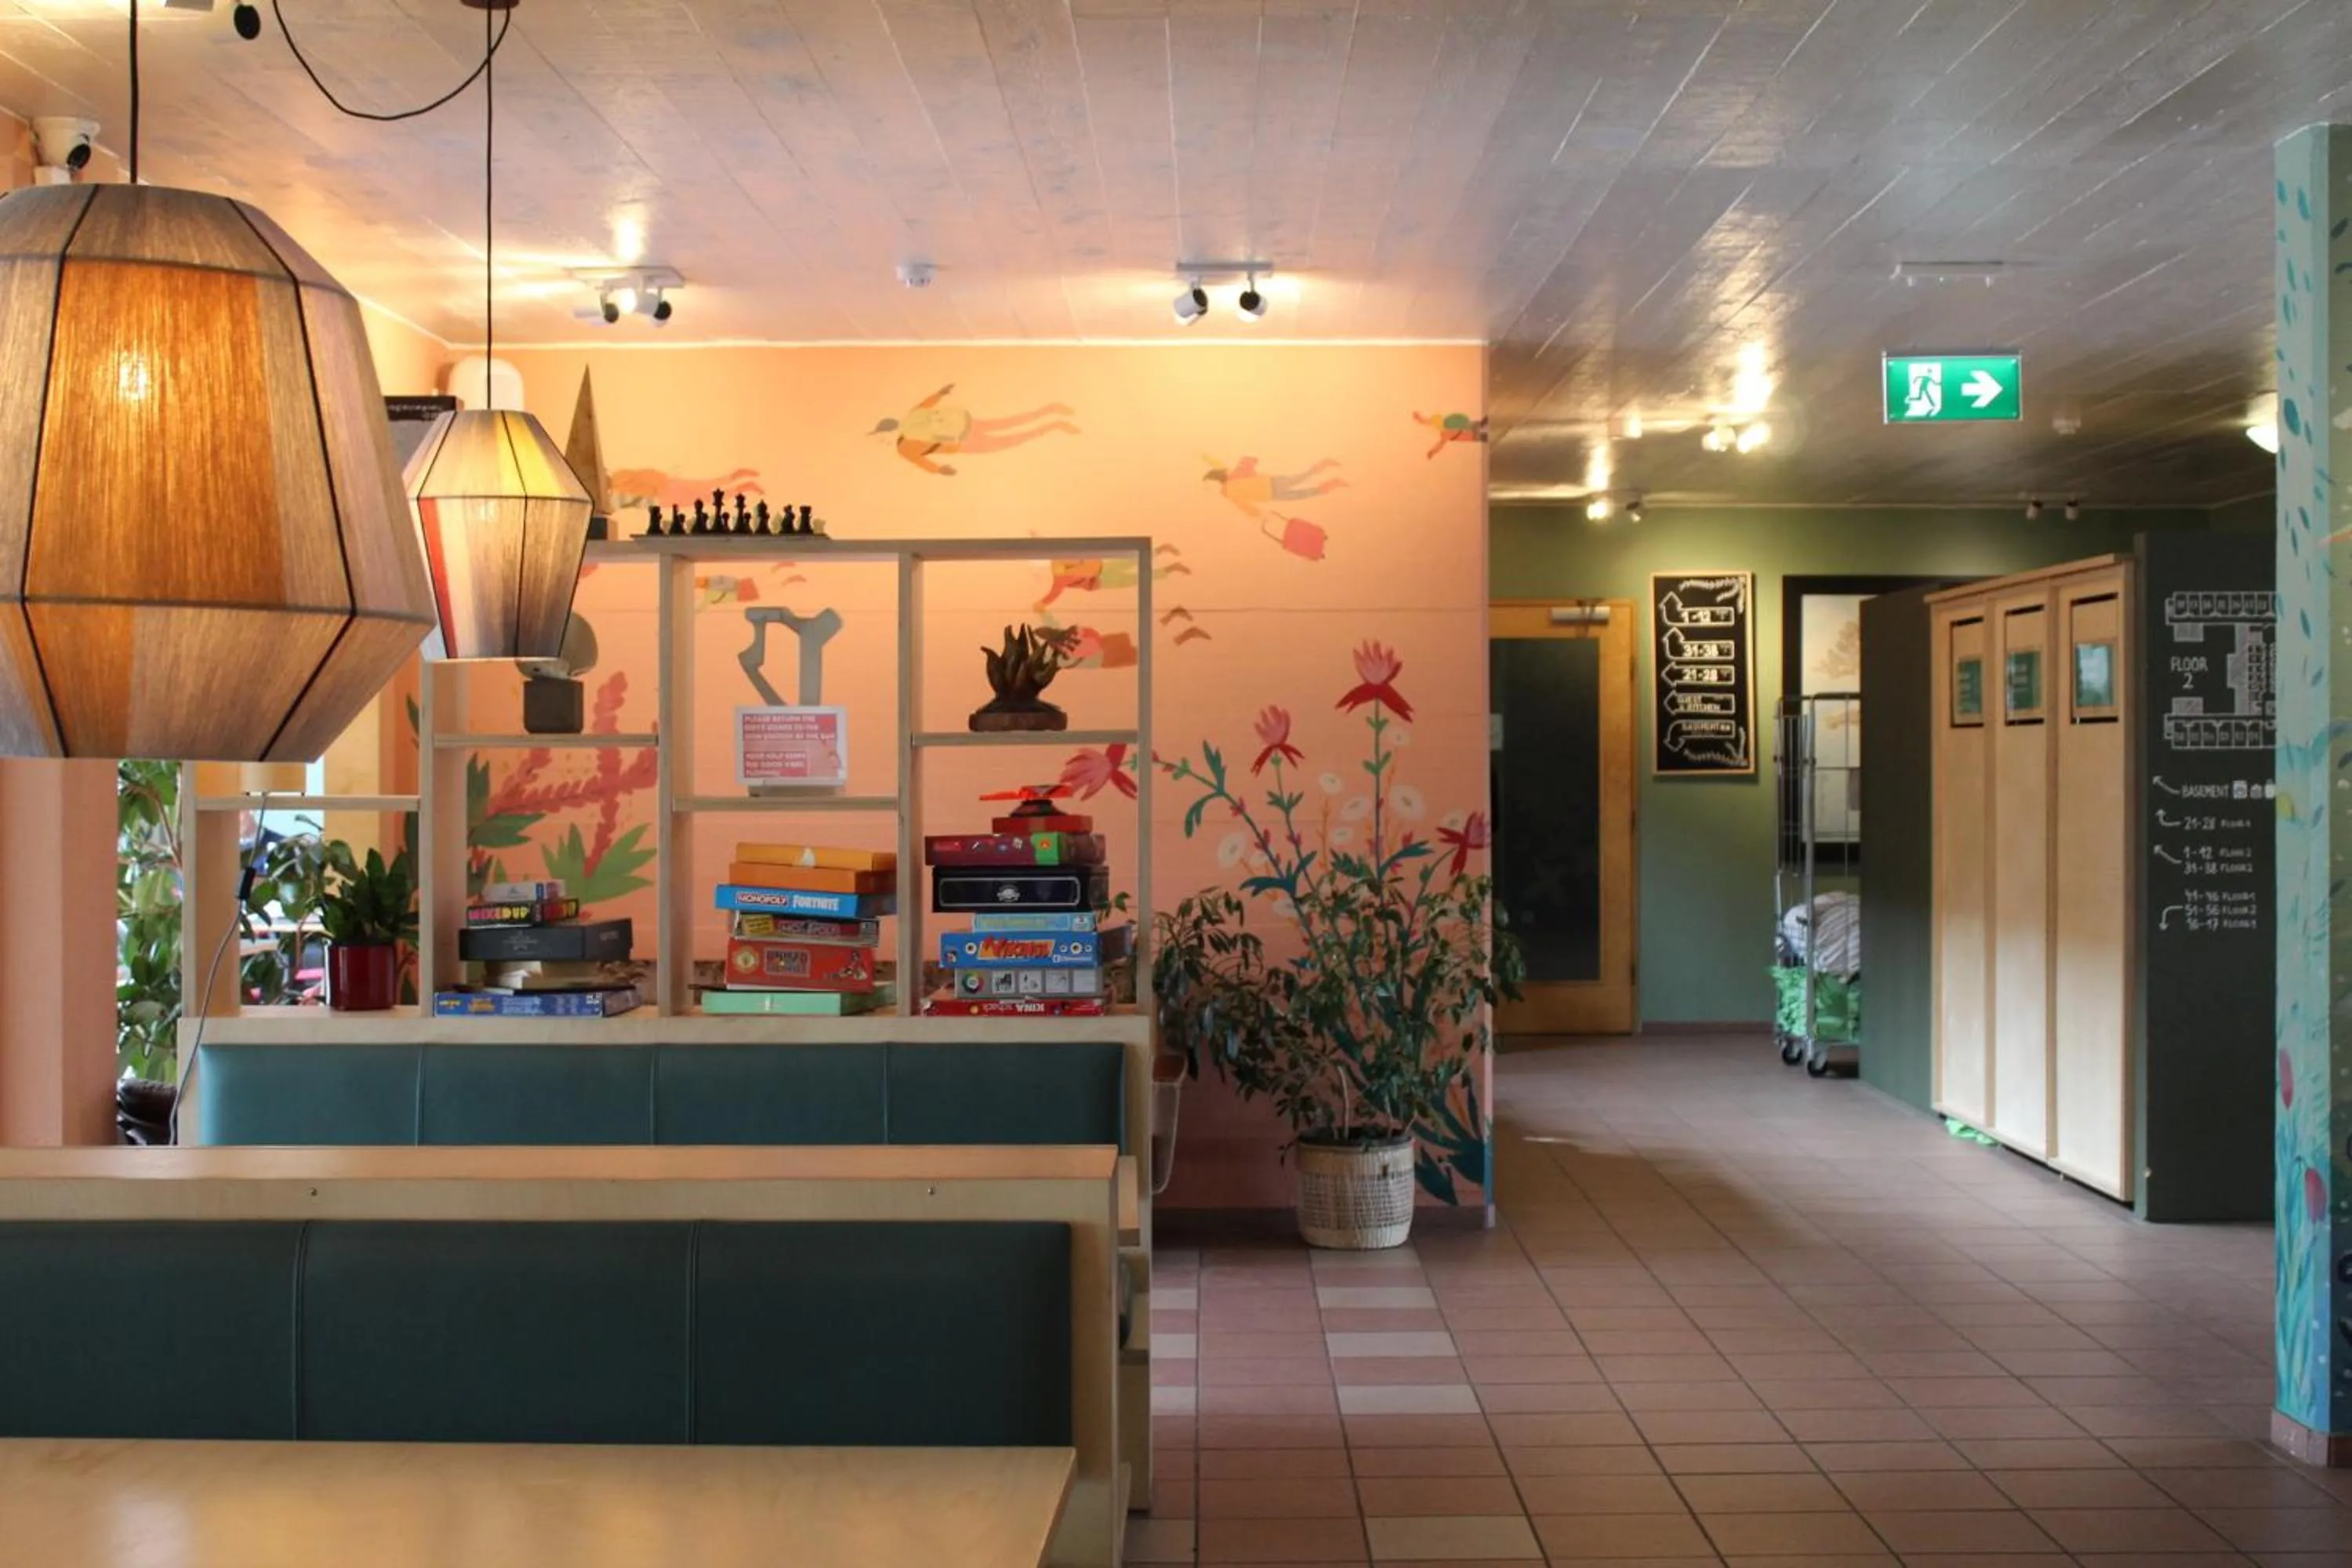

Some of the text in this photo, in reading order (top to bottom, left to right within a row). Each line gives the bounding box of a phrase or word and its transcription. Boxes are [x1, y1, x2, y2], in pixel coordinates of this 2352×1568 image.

[2170, 656, 2209, 672] FLOOR
[2182, 673, 2194, 690] 2
[2182, 784, 2230, 798] BASEMENT
[739, 893, 840, 911] MONOPOLY FORTNITE
